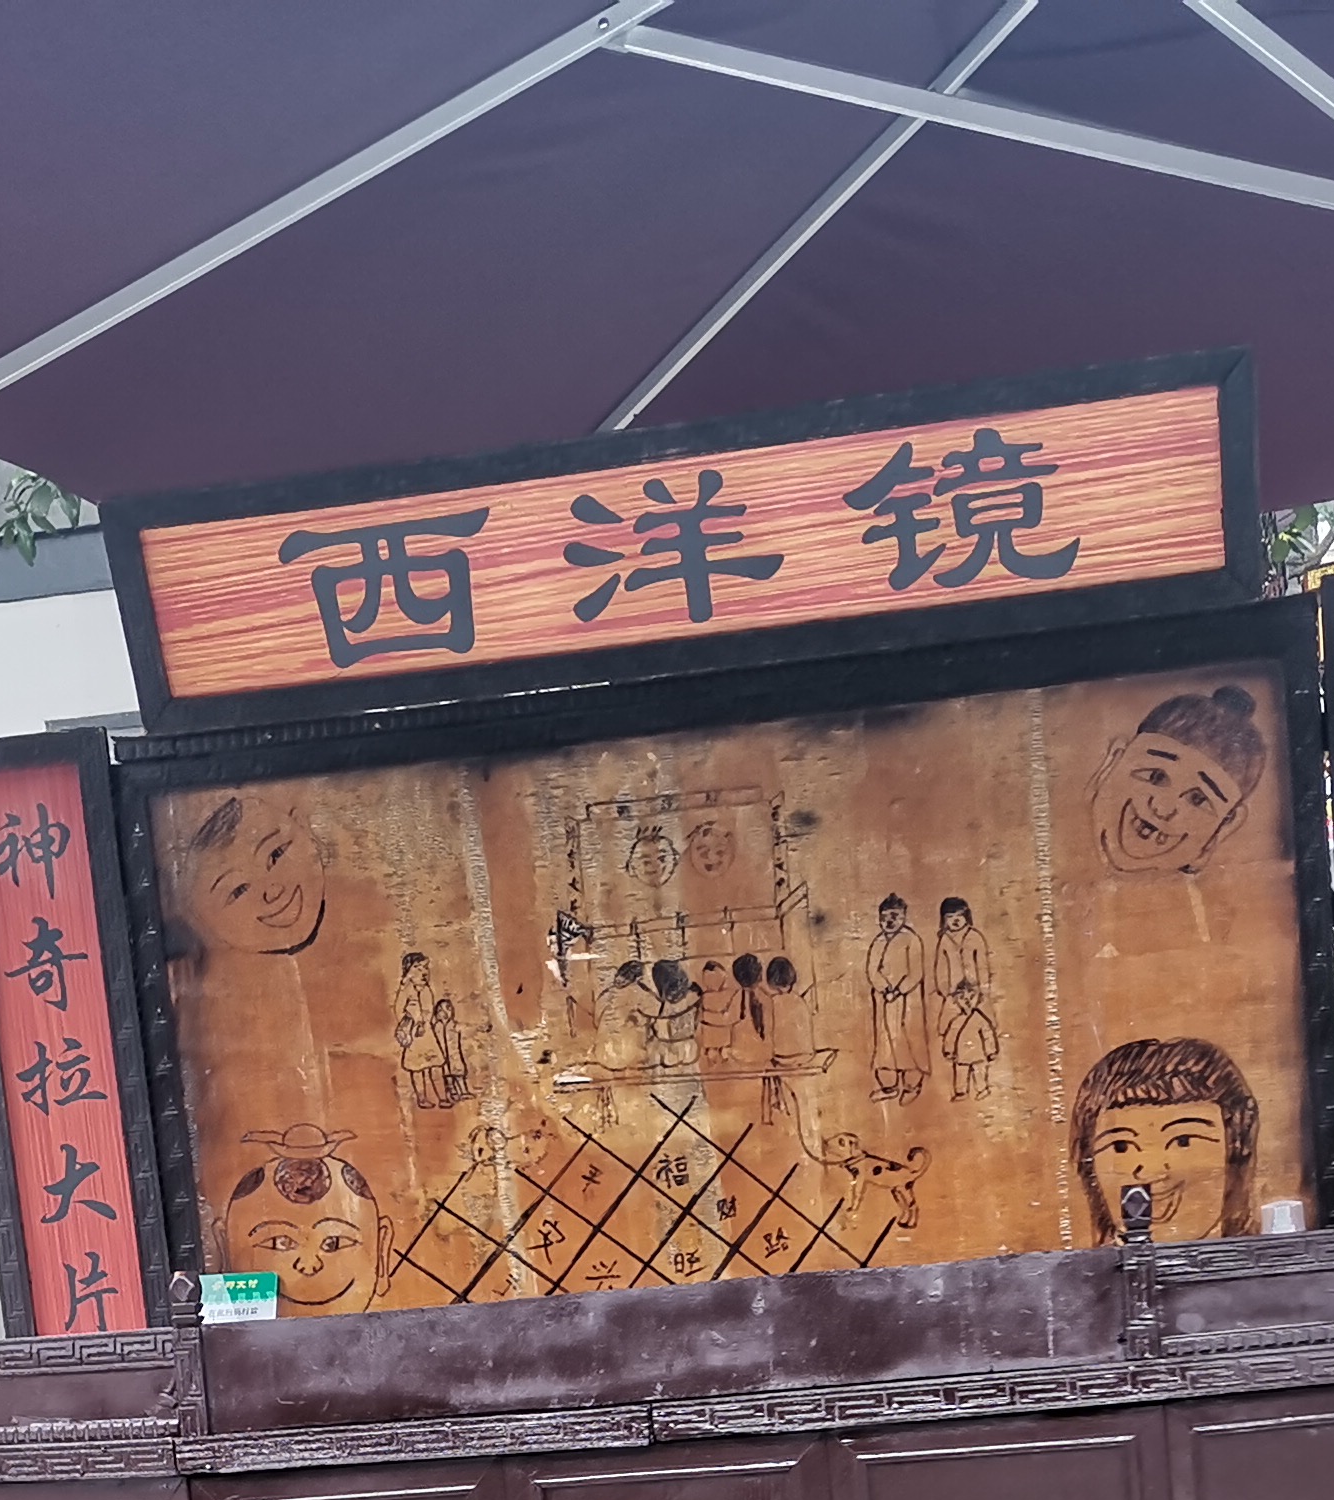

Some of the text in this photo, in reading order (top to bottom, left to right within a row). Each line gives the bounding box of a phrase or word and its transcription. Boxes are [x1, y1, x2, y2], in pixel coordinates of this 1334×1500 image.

[278, 428, 1080, 668] 西洋镜
[656, 1153, 689, 1189] 福
